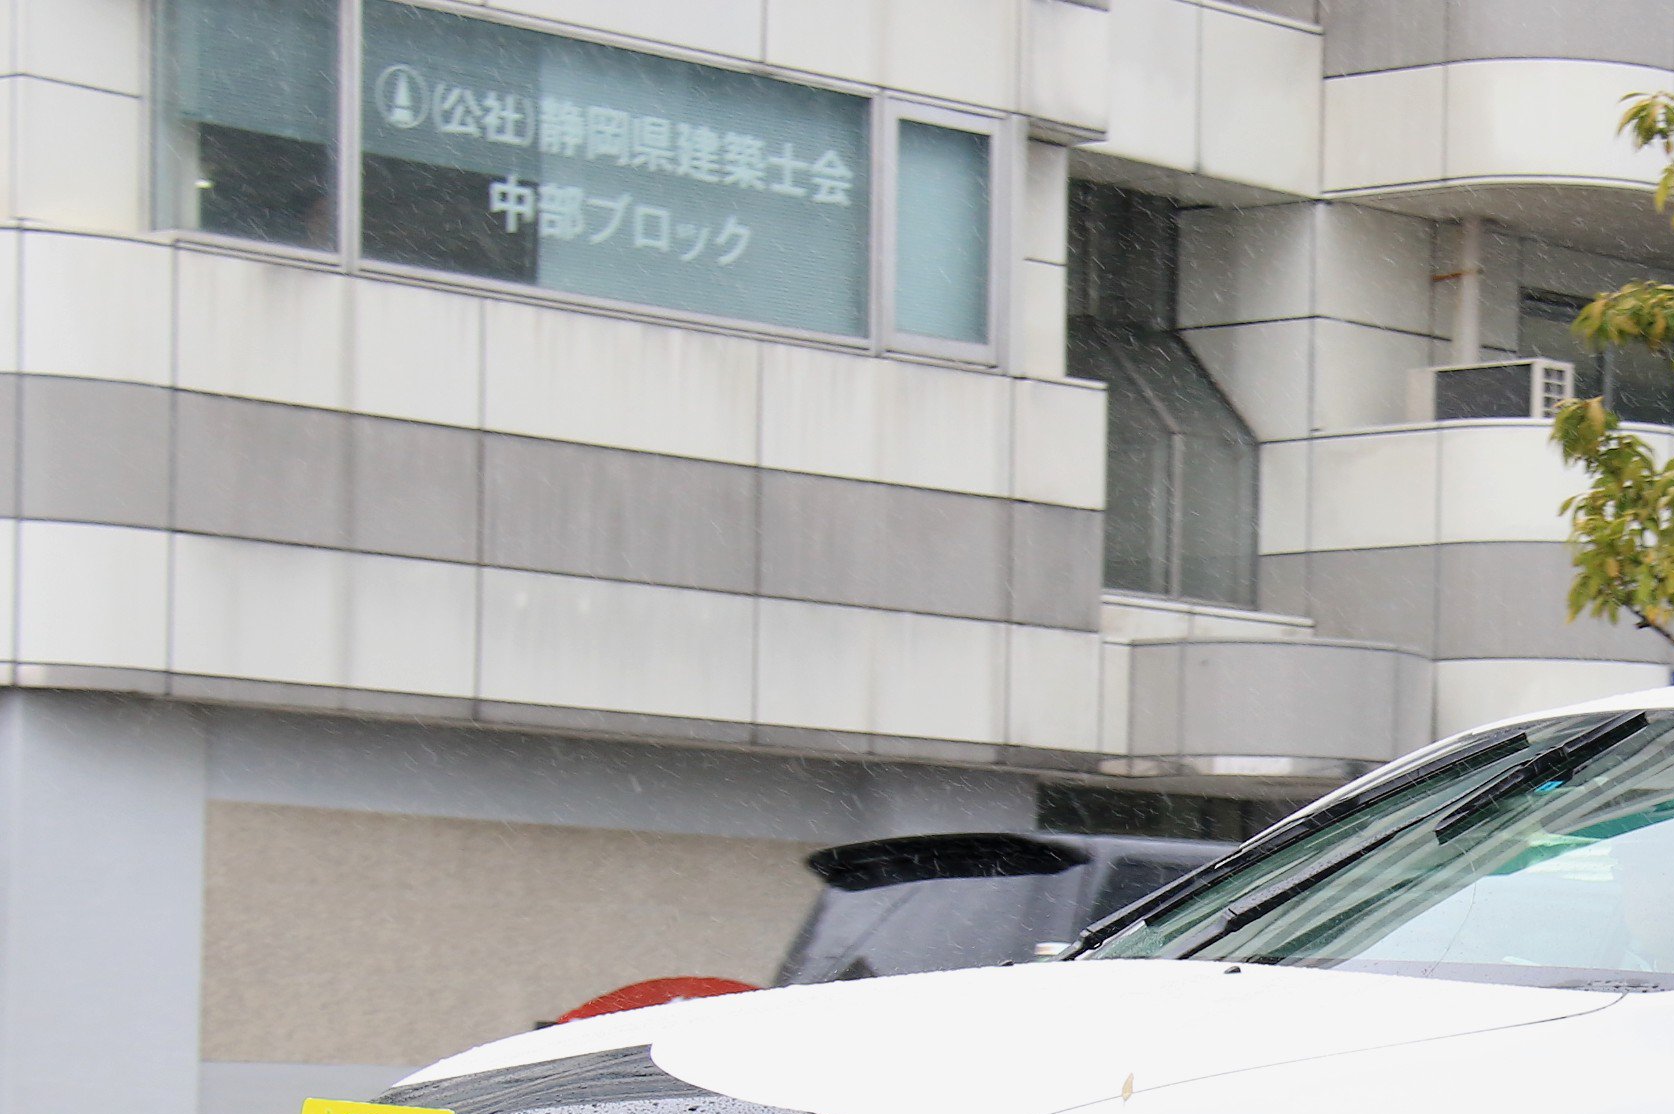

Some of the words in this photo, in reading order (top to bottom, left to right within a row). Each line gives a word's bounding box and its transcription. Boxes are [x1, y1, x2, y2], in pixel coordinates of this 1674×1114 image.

[489, 173, 751, 266] 中部ブロック
